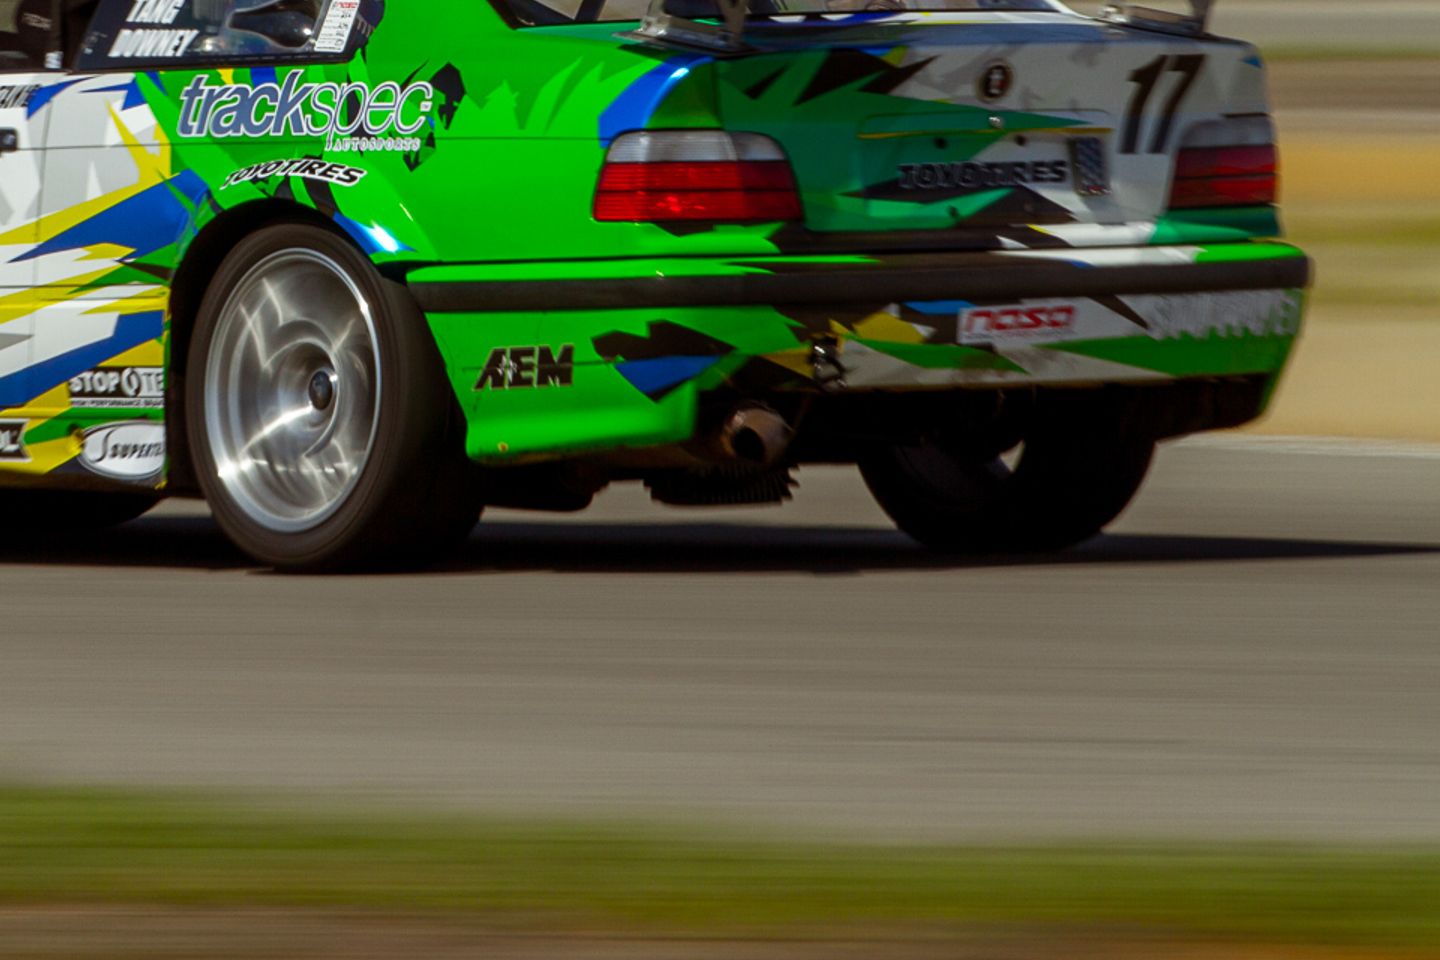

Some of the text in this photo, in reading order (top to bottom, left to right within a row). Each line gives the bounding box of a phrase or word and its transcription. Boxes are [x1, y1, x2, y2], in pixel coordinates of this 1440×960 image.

[177, 68, 433, 151] trackspec
[1118, 54, 1208, 154] 17
[333, 138, 421, 152] AUTOSPORTS
[472, 343, 574, 391] AEM
